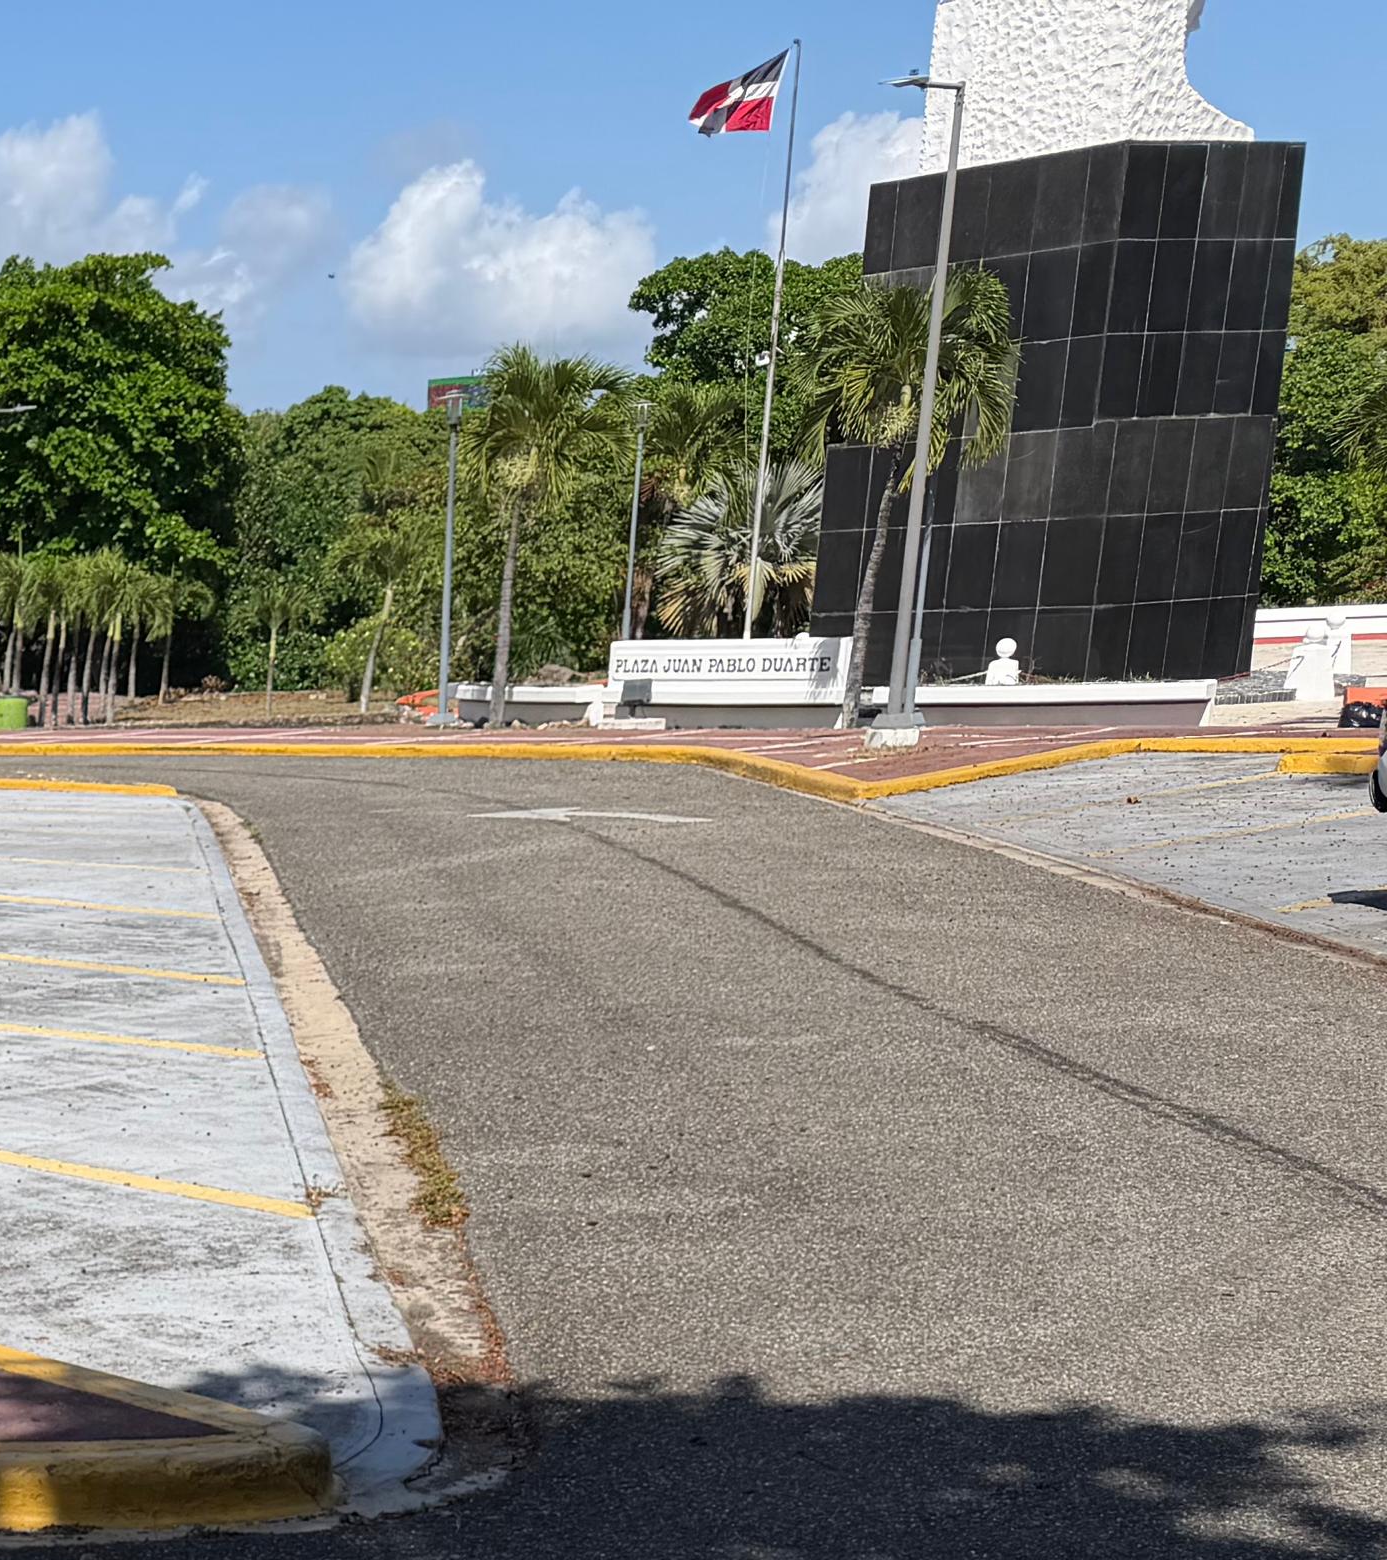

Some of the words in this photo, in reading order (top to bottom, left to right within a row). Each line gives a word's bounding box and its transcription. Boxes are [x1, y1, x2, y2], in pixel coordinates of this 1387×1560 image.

[615, 659, 658, 673] PLAZA
[663, 658, 702, 673] JUAN
[708, 658, 756, 673] PABLO
[761, 656, 831, 673] DUARTE
